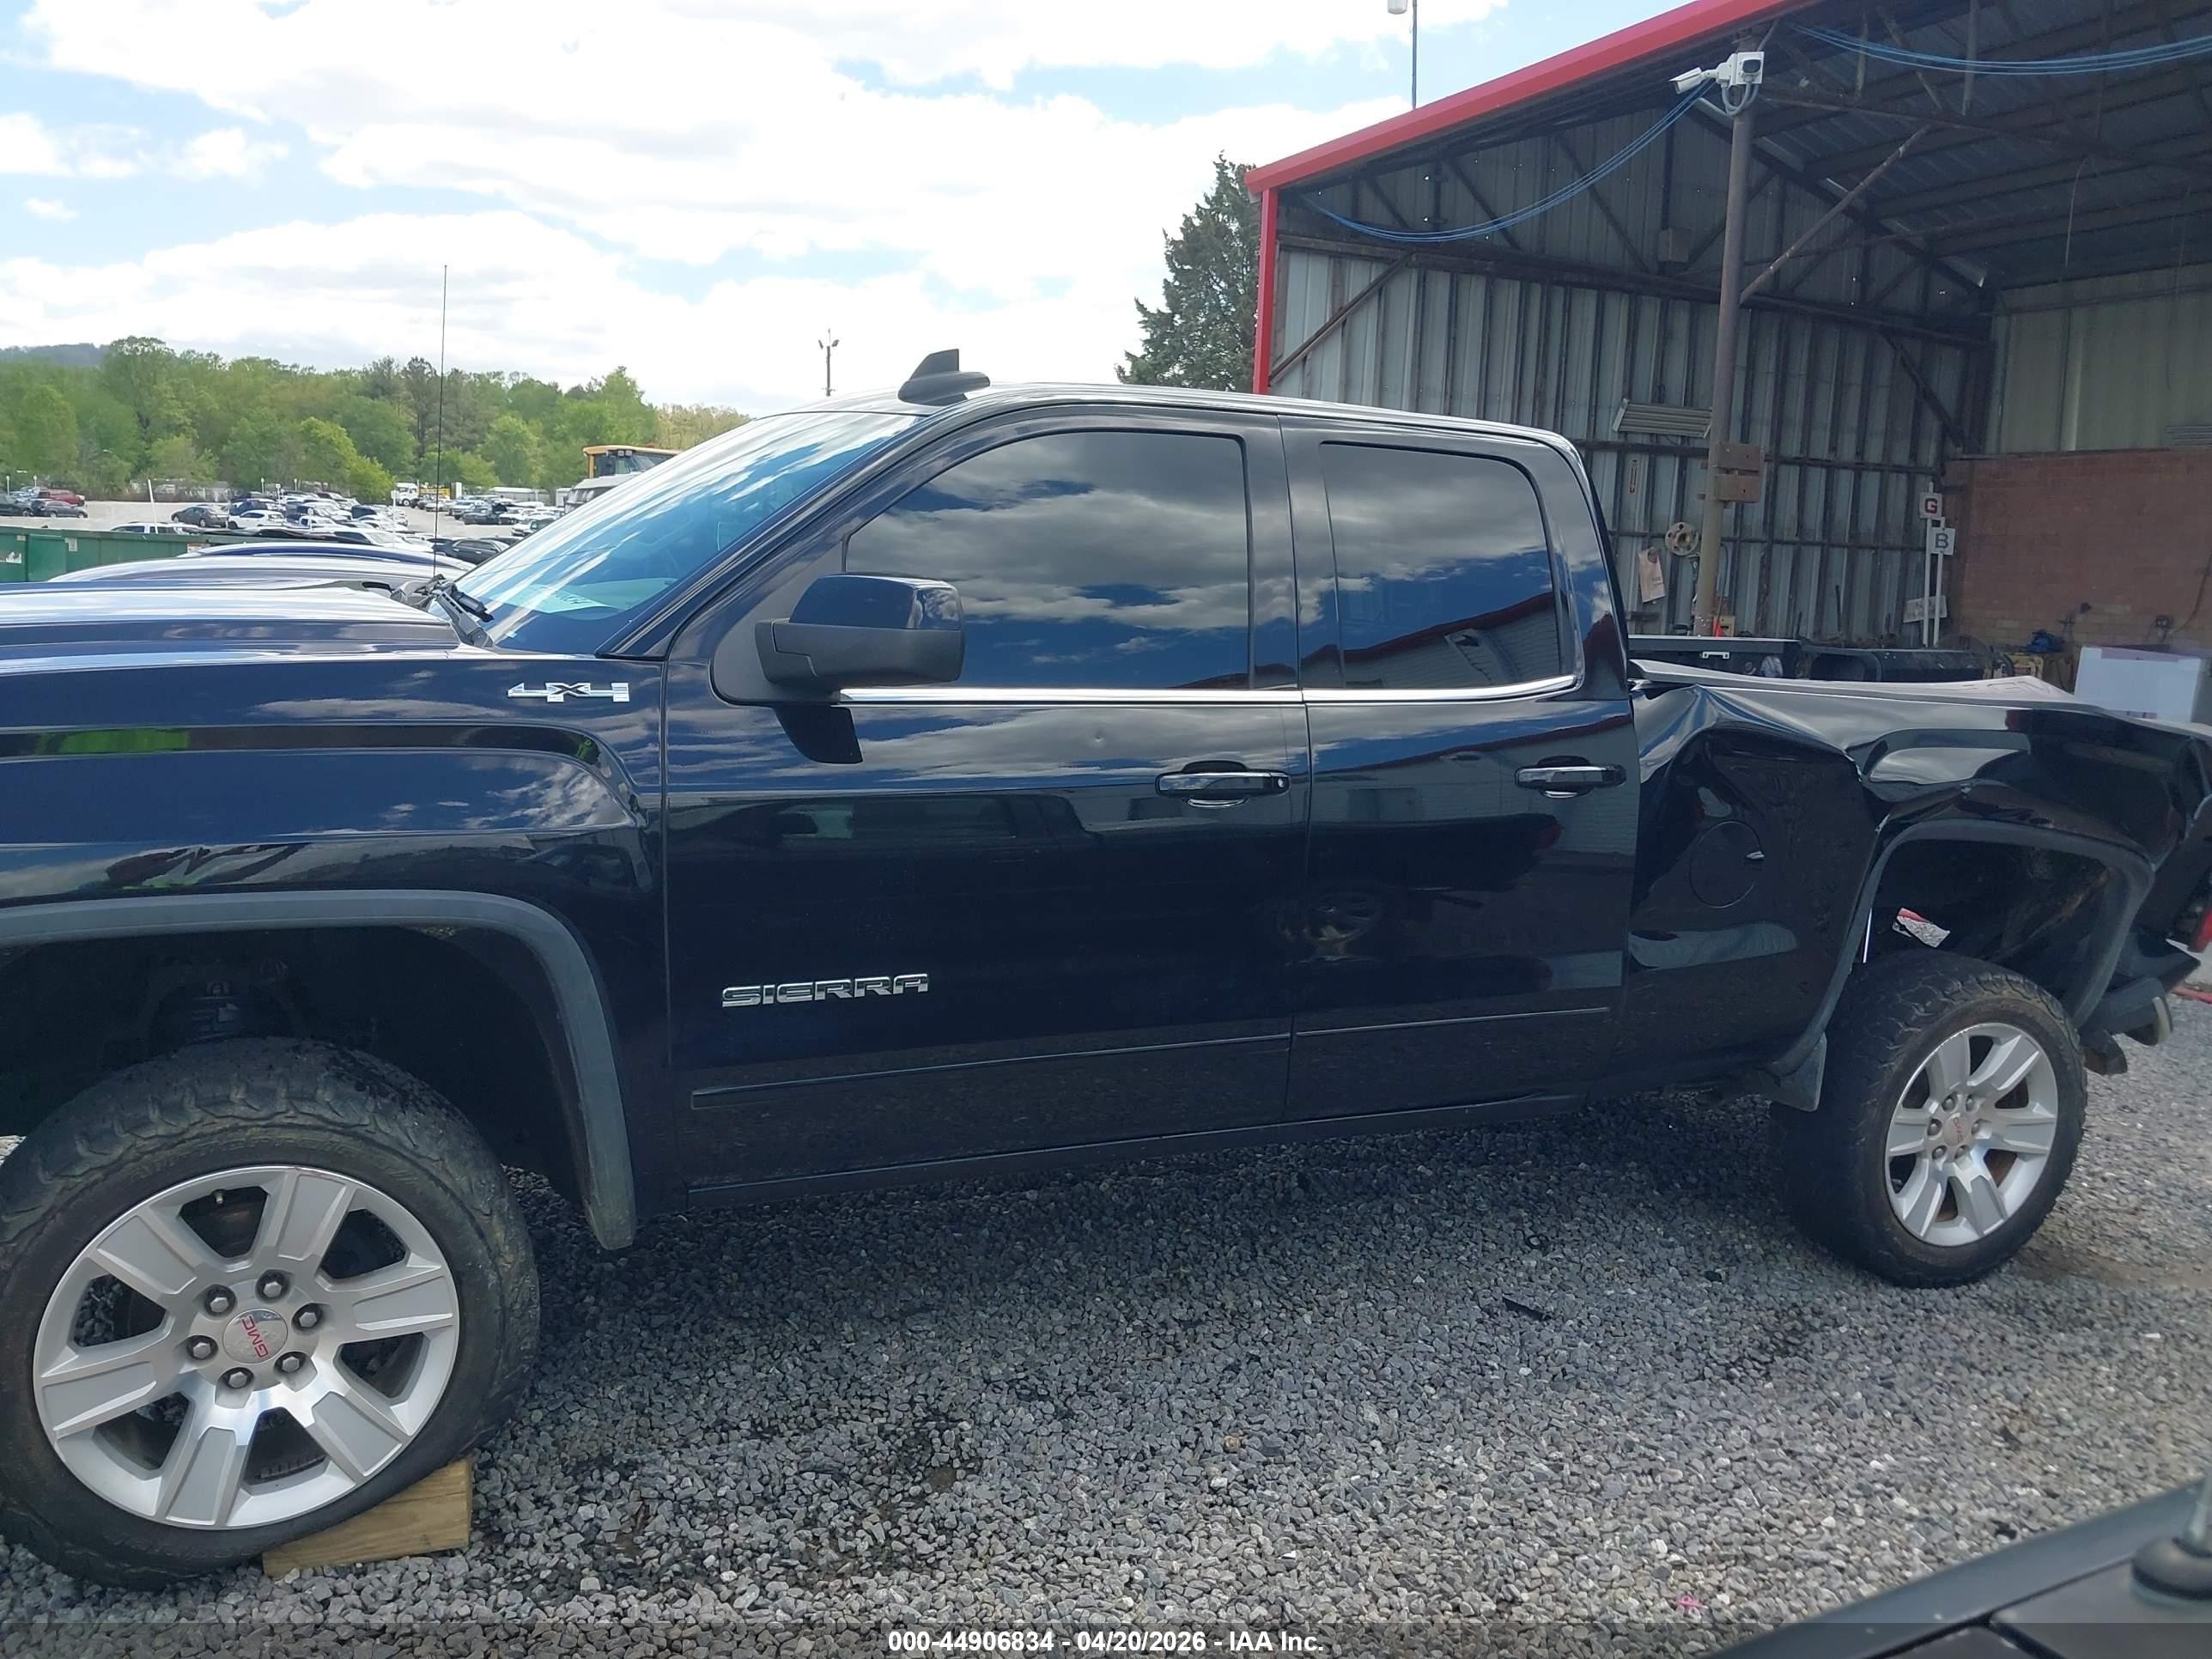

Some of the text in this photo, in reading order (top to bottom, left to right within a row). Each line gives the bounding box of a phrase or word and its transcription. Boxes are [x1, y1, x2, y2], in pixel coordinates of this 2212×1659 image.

[1923, 497, 1938, 514] G
[1935, 532, 1949, 550] B
[721, 973, 929, 1007] SIERRA
[240, 1315, 269, 1358] GMC
